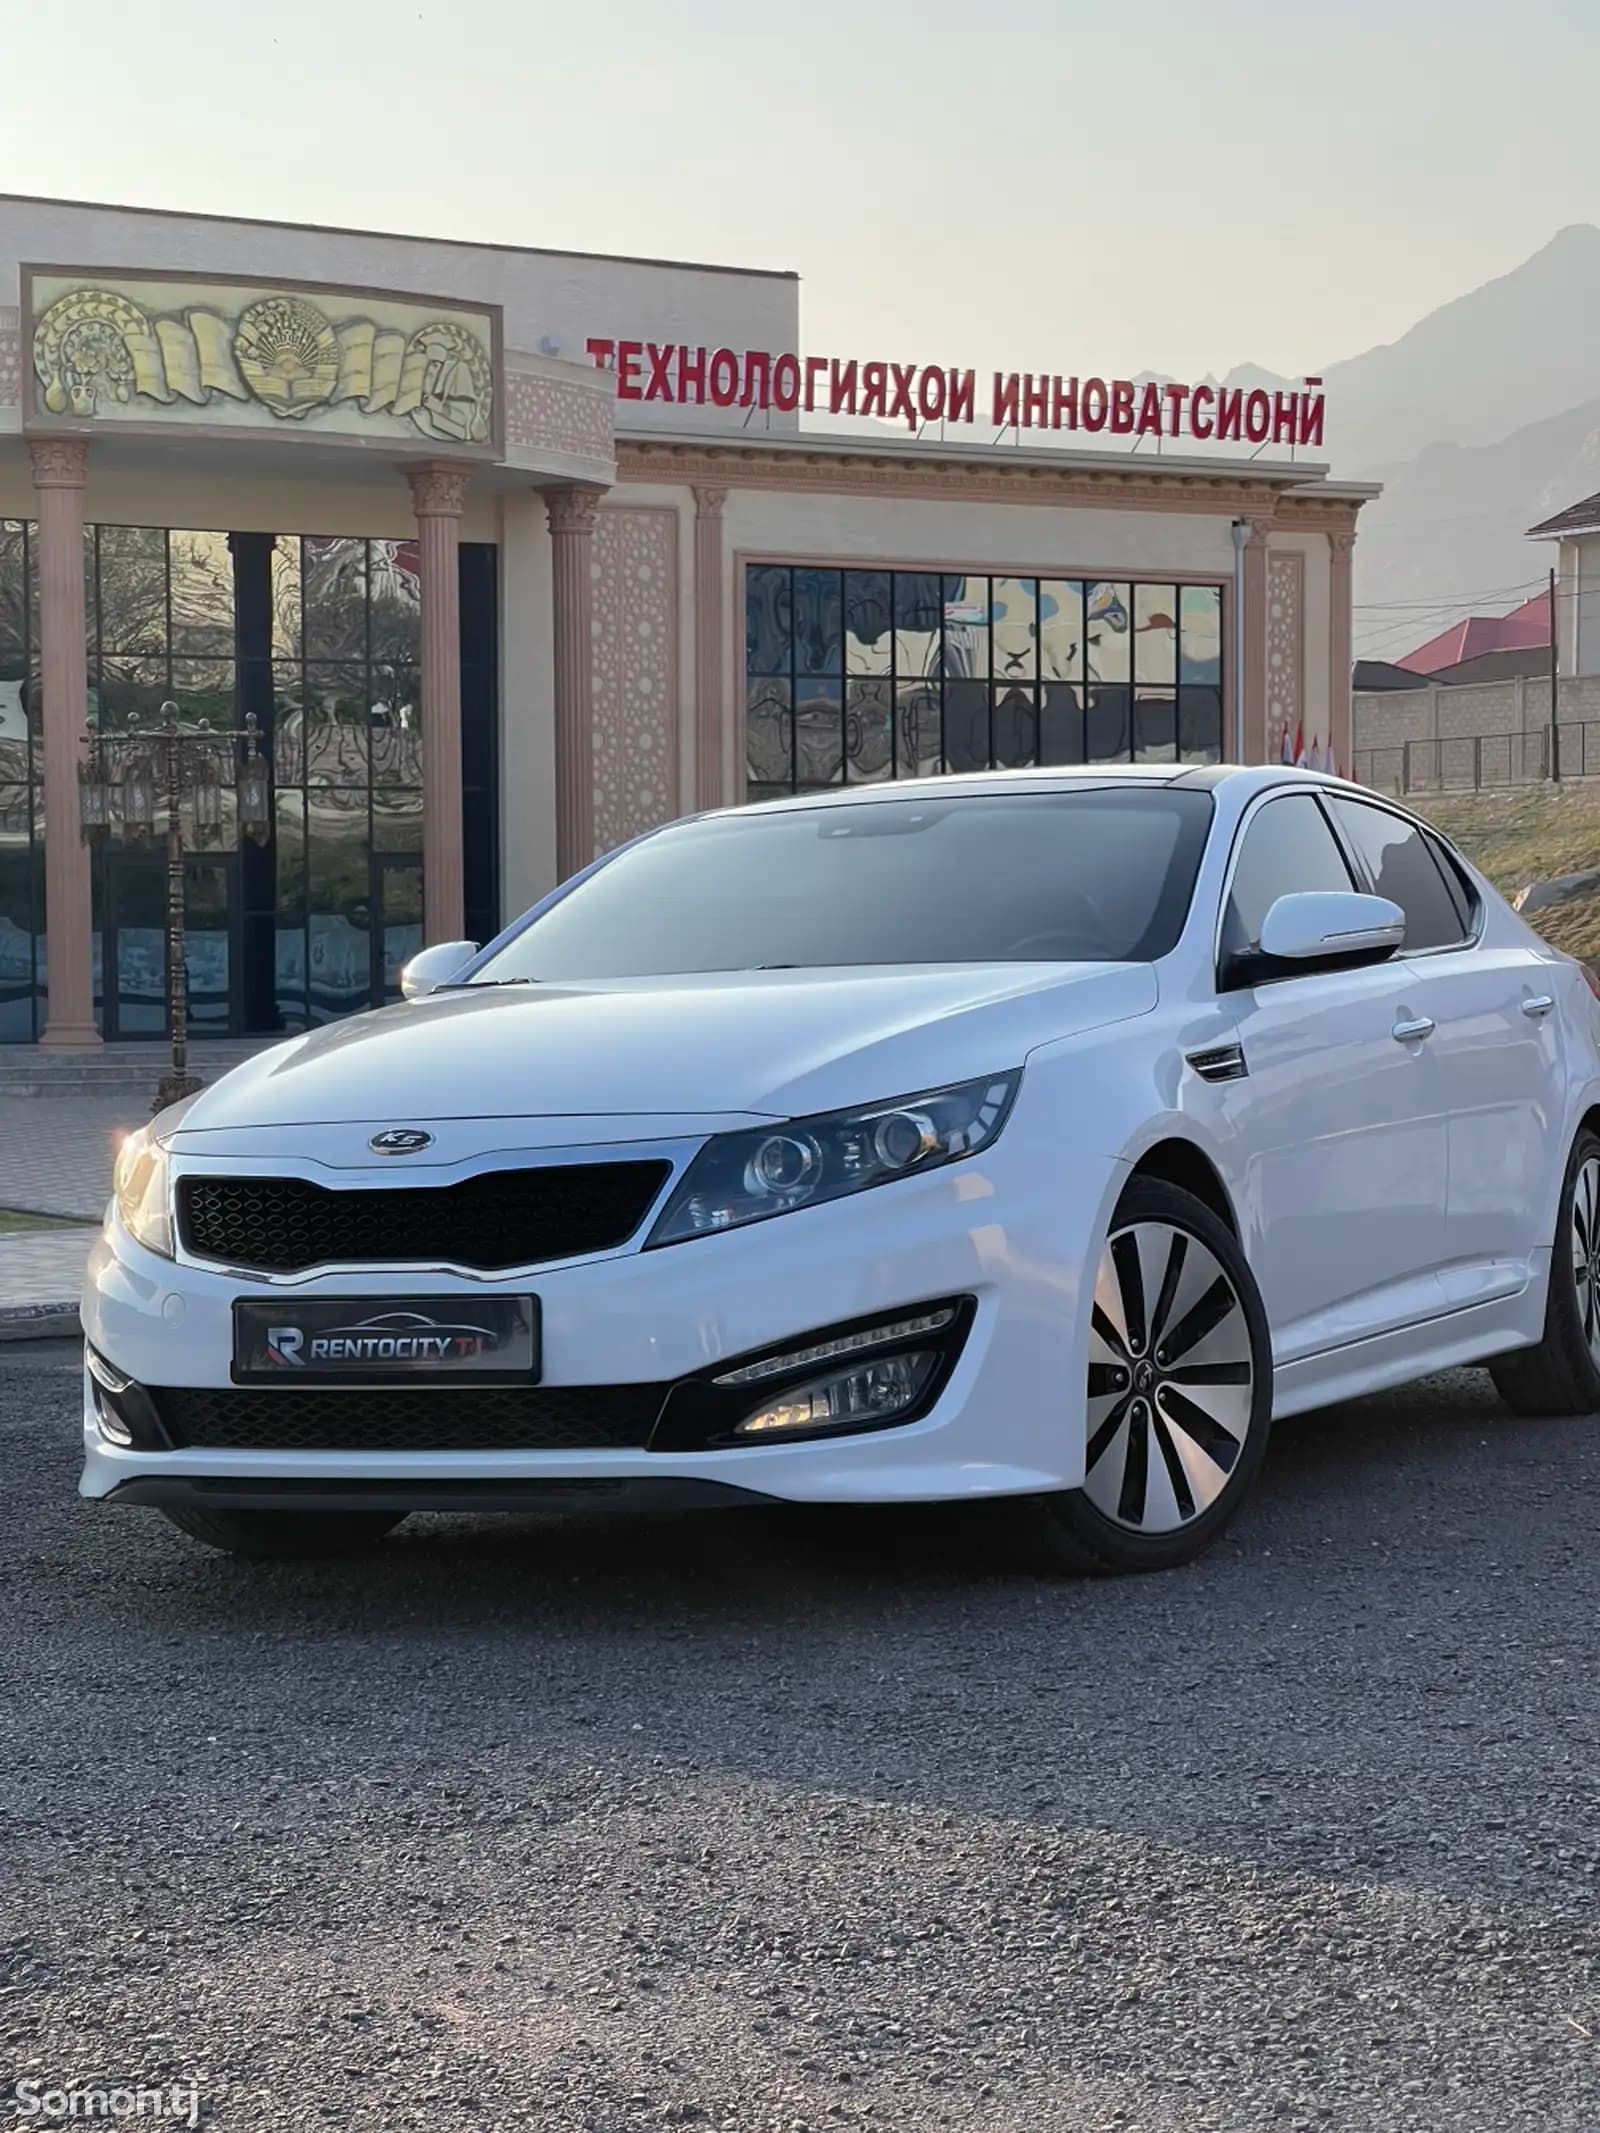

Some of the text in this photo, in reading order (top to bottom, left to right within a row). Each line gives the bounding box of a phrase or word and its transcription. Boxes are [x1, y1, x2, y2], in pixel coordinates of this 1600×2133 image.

[586, 337, 1325, 446] ТЕХНОЛОГИЯҲОИ ИННОВАТСИОНӢ
[310, 1336, 451, 1359] RENTOCITY
